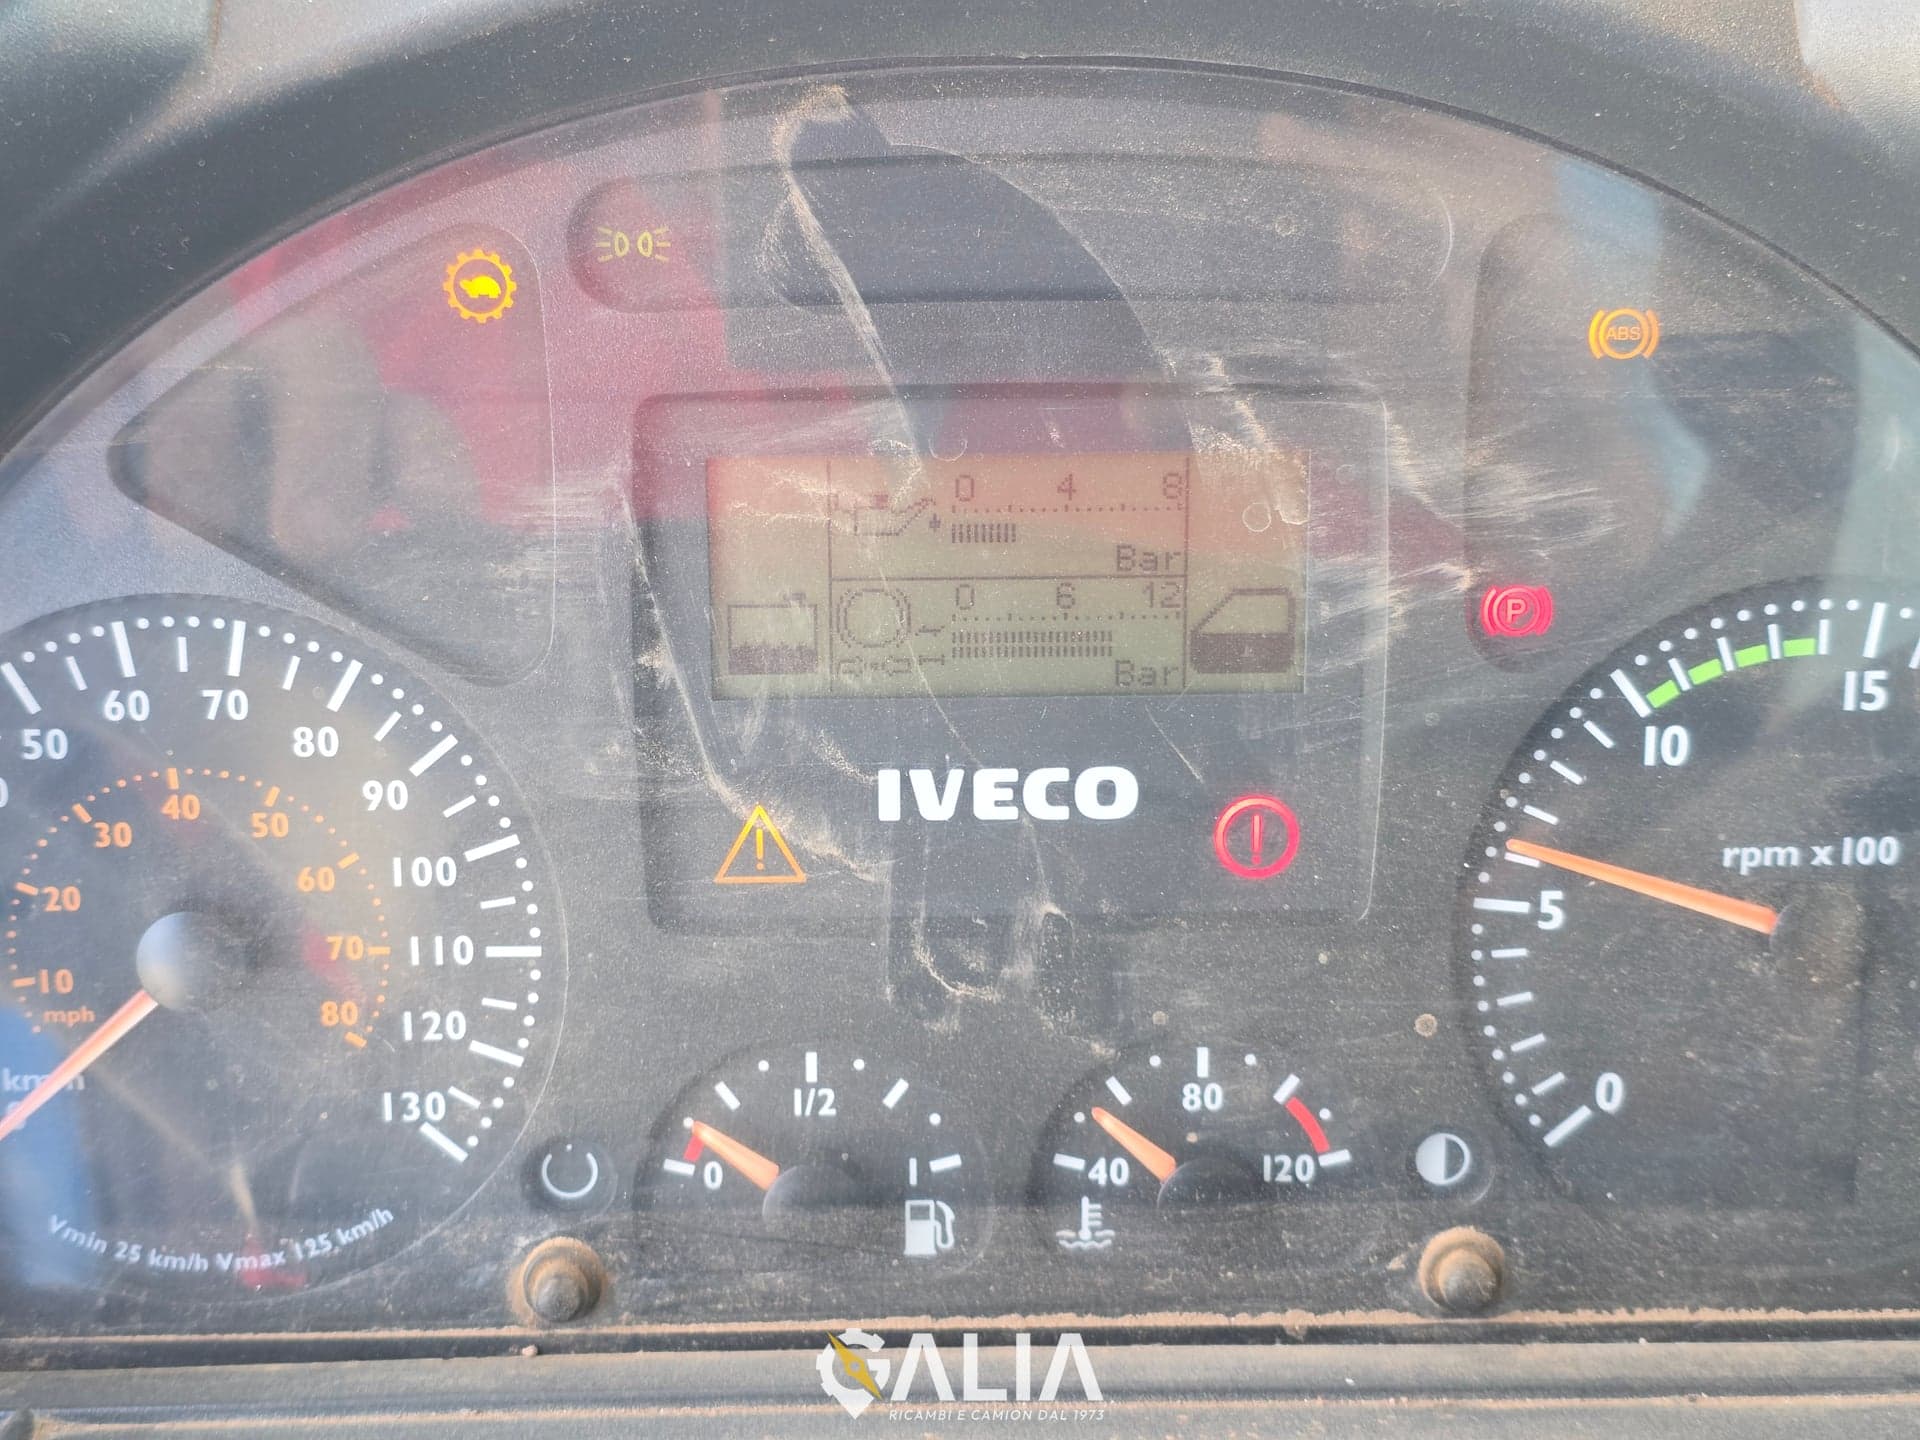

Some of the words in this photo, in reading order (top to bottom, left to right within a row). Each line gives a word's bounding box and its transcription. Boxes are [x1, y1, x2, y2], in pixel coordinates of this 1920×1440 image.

[1607, 325, 1641, 341] ABS
[1056, 473, 1076, 500] 4
[1116, 545, 1182, 573] Bar
[954, 584, 975, 610] 0
[1056, 583, 1076, 609] 6
[1506, 598, 1528, 624] P
[1115, 659, 1181, 686] Bar
[202, 689, 249, 721] 70
[1842, 670, 1889, 712] 15
[102, 690, 150, 722] 60
[20, 729, 68, 761] 50
[292, 726, 339, 758] 80
[1643, 726, 1690, 767] 10
[362, 780, 408, 811] 90
[877, 766, 1139, 821] IVECO
[161, 795, 201, 821] 40
[94, 822, 132, 848] 30
[251, 813, 289, 839] 50
[392, 856, 457, 888] 100
[1722, 845, 1800, 874] rpm
[298, 866, 335, 892] 60
[43, 886, 81, 912] 20
[1537, 890, 1563, 931] 5
[327, 936, 364, 961] 70
[410, 936, 474, 966] 110
[38, 969, 74, 994] 10
[43, 1006, 95, 1026] mph
[321, 1002, 358, 1026] 80
[403, 1010, 467, 1042] 120
[793, 1088, 836, 1116] 1/2
[1182, 1083, 1224, 1111] 80
[1595, 1072, 1624, 1111] 0
[382, 1091, 446, 1121] 130
[703, 1163, 723, 1189] 0
[1087, 1158, 1130, 1185] 40
[1263, 1153, 1315, 1183] 120
[49, 1215, 107, 1253] Vmin
[115, 1241, 142, 1264] 25
[149, 1247, 209, 1272] km/h
[215, 1250, 286, 1271] Vmax
[294, 1235, 333, 1260] 125
[338, 1207, 394, 1243] km/h
